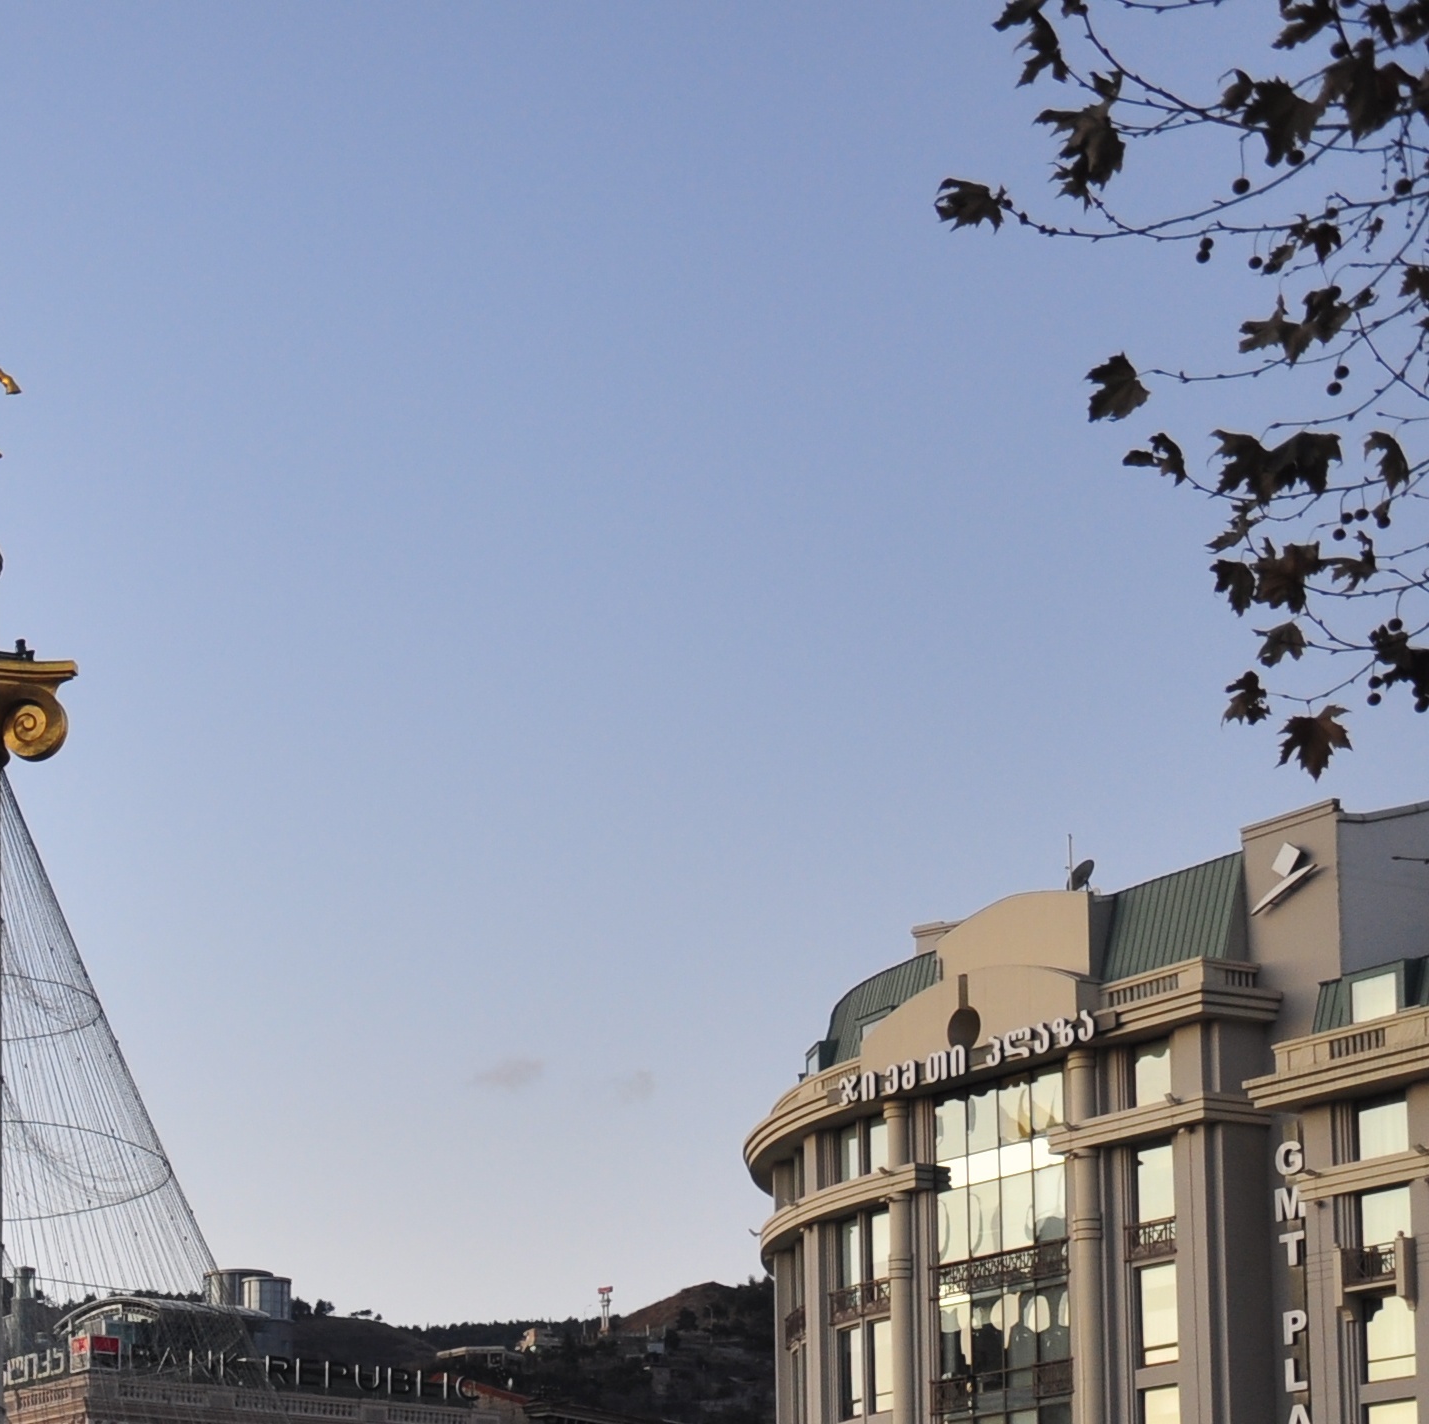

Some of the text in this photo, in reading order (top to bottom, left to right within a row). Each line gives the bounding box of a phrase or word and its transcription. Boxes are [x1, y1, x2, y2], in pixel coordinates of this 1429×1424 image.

[838, 1009, 1095, 1107] ჯი ემ თი პლაზა
[1274, 1141, 1306, 1266] GMT
[265, 1354, 480, 1401] REPUBLIC
